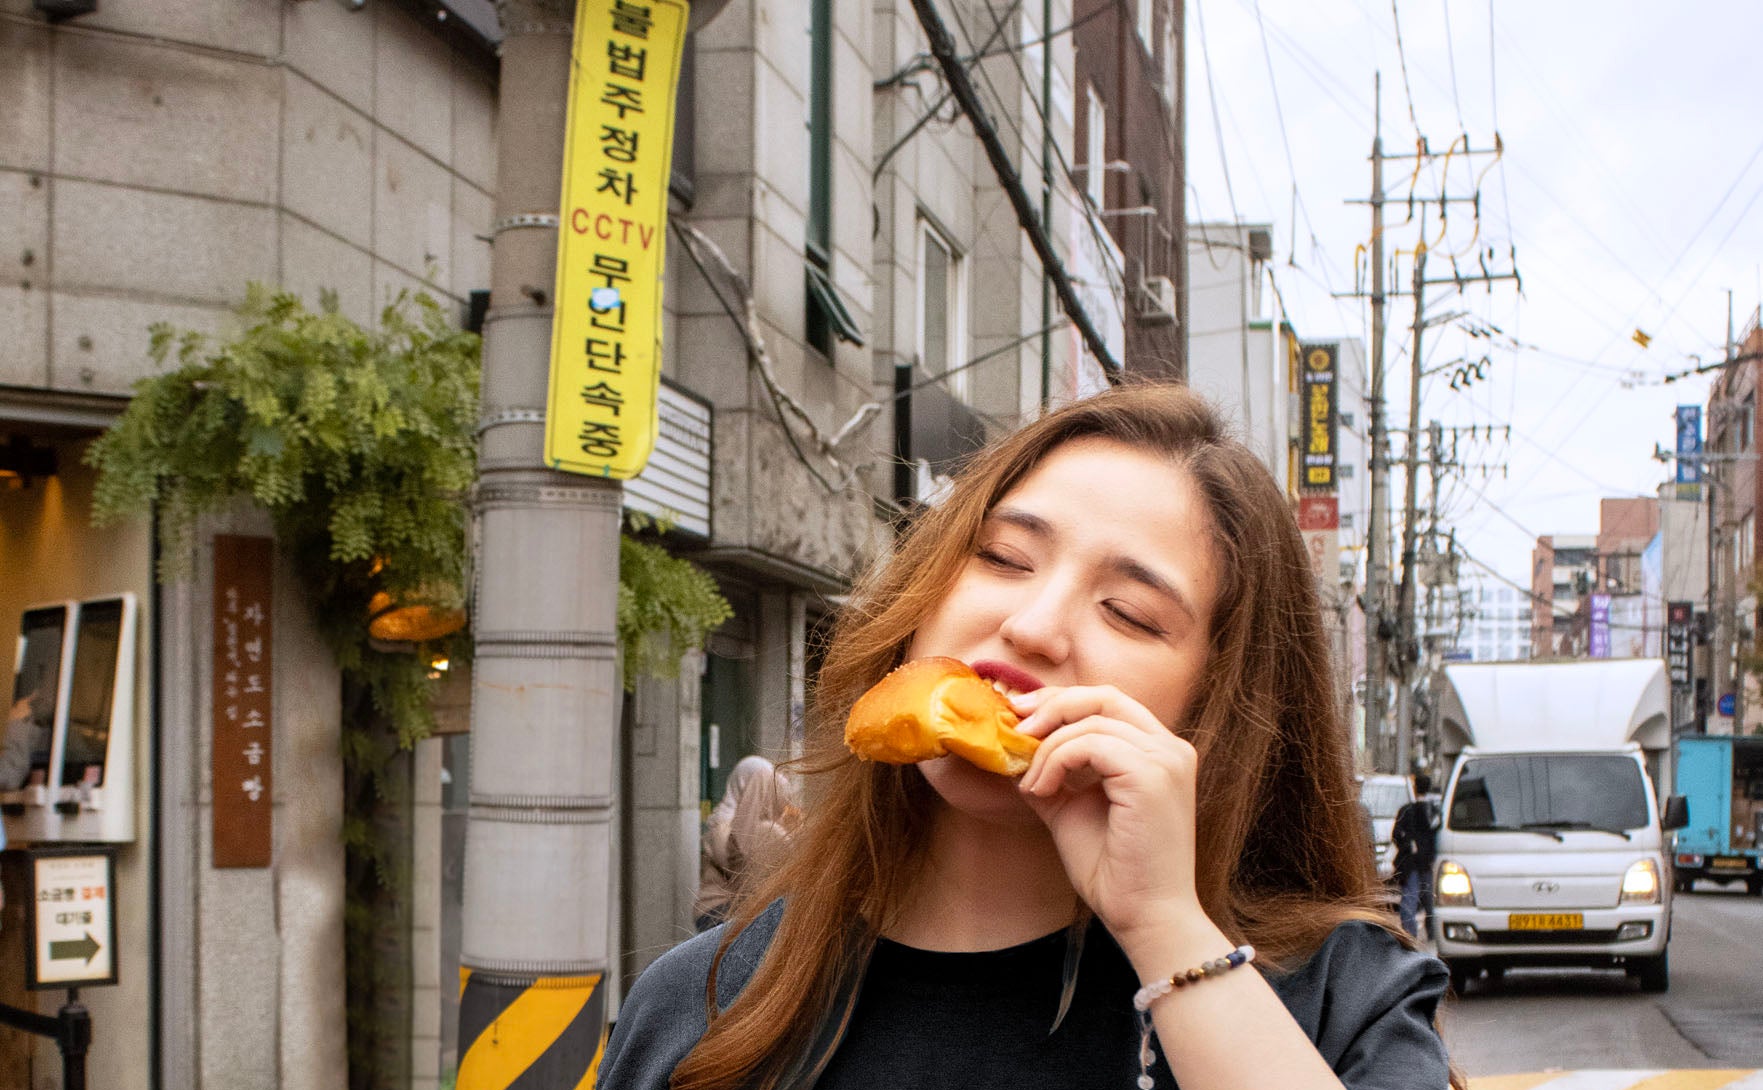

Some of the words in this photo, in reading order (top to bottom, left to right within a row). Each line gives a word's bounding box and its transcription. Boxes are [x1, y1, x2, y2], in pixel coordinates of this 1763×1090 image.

[596, 0, 654, 206] 불법주정차
[572, 208, 654, 250] CCTV
[578, 253, 632, 458] 무인단속중
